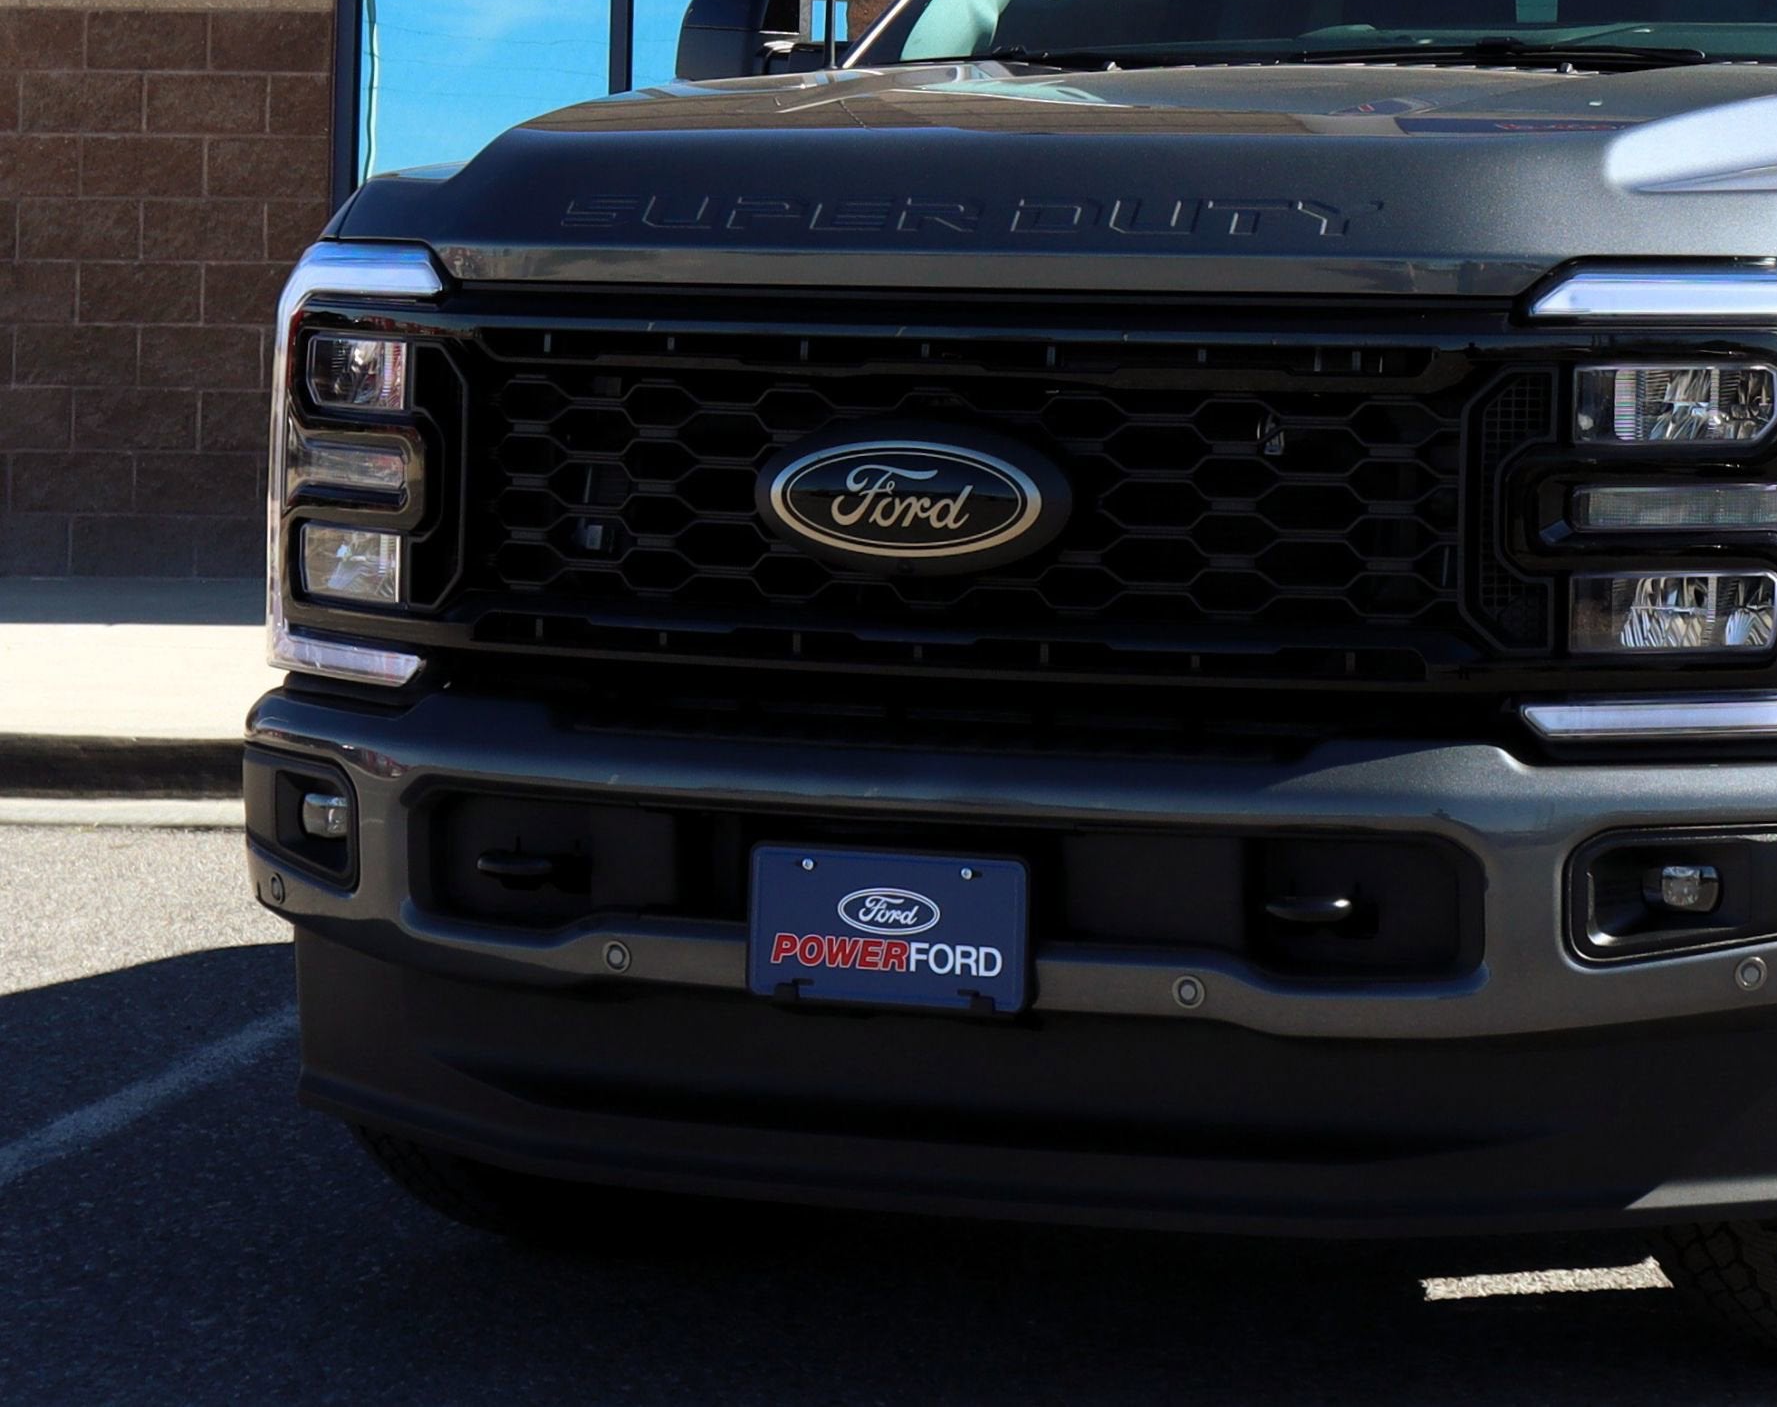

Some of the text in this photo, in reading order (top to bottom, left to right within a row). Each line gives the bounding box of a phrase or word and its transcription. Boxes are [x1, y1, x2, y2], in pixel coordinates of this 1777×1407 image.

[560, 195, 1386, 236] SUPER DUTY
[831, 464, 973, 530] Ford
[858, 896, 919, 925] Ford
[770, 932, 1003, 978] POWERFORD
